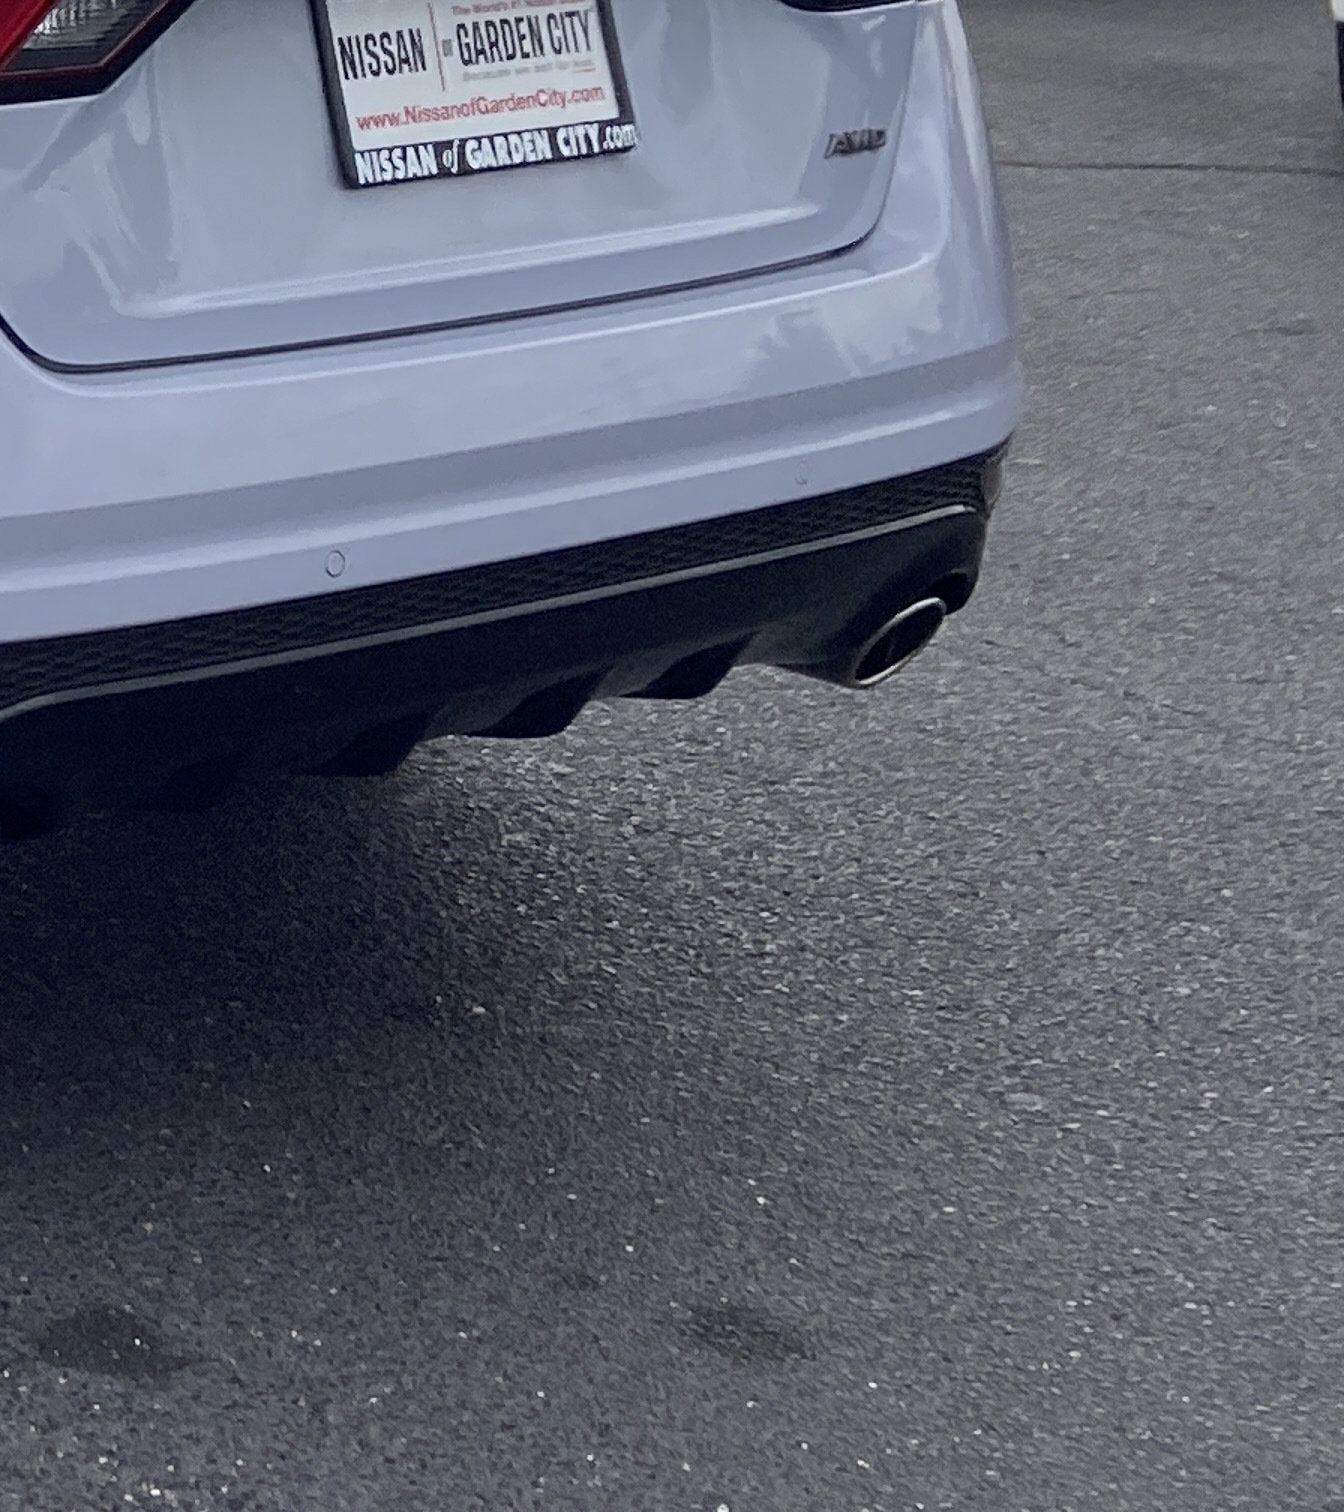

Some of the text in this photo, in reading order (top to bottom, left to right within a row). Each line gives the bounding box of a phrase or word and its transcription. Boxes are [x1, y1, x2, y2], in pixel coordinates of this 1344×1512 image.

[337, 28, 426, 80] NISSAN
[456, 15, 545, 67] GARDEN
[547, 9, 592, 55] CITY
[356, 86, 606, 131] www.NissanofGardenCity.com
[354, 144, 439, 185] NISSAN
[442, 138, 460, 173] of
[465, 129, 553, 170] GARDEN
